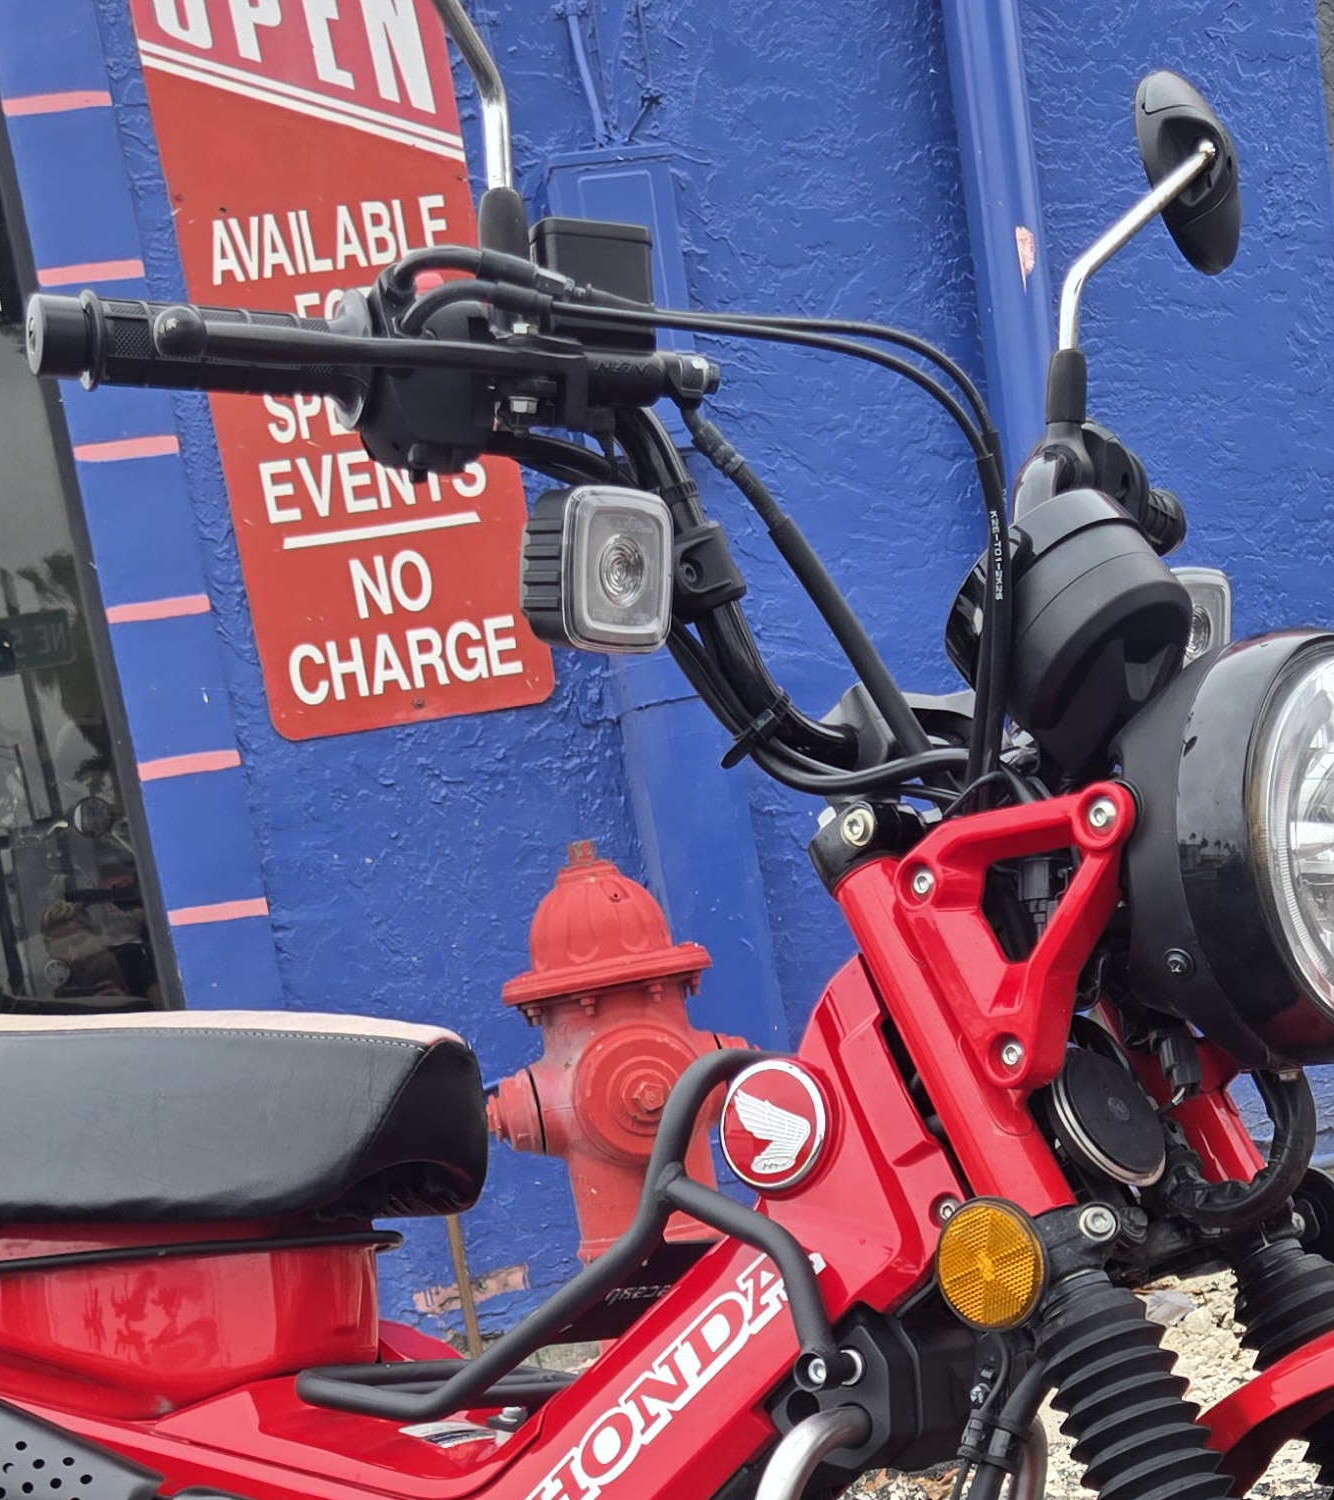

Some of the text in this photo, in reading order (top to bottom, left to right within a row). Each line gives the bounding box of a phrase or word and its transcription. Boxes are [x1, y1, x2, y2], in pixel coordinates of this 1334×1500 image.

[212, 194, 448, 286] AVAILABLE
[348, 550, 434, 619] NO
[289, 615, 524, 705] CHARGE
